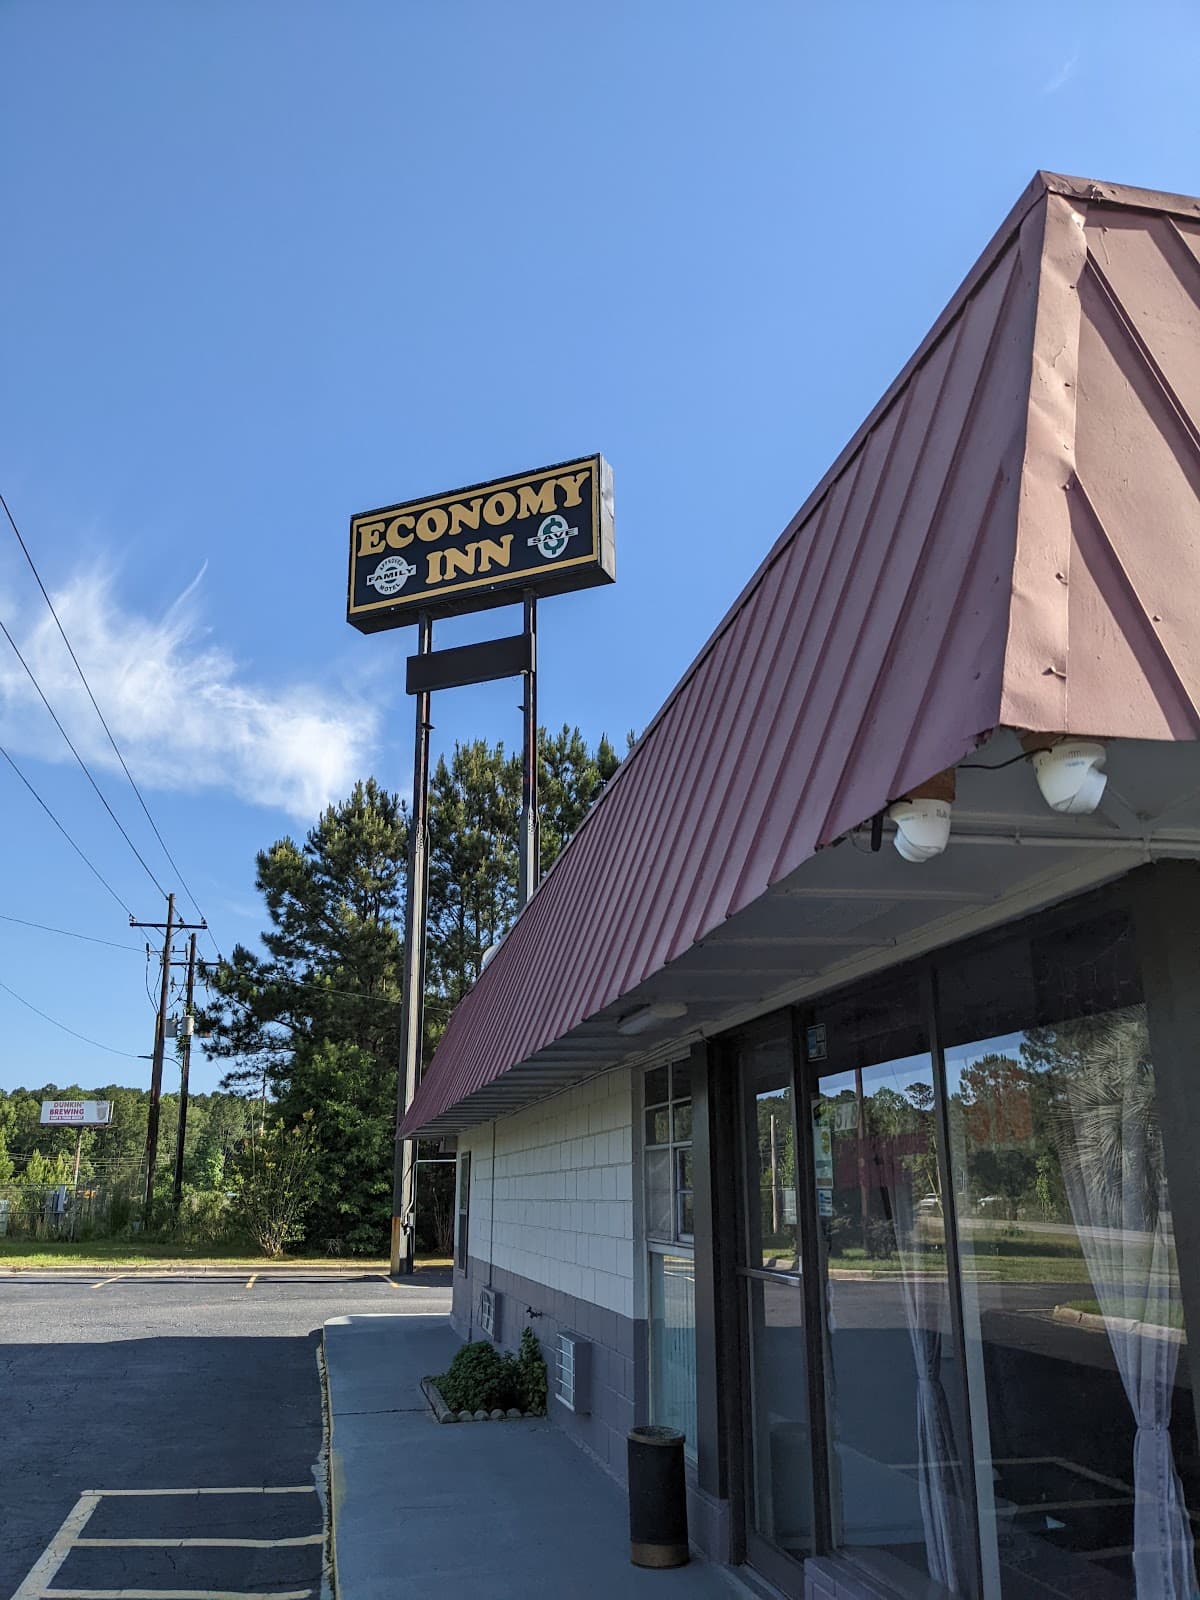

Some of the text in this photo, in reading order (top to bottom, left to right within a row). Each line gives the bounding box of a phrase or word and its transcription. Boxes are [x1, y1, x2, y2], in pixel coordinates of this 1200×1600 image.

[357, 471, 591, 557] ECONOMY
[532, 528, 575, 544] SAVE
[425, 534, 514, 584] INN
[368, 567, 414, 583] FAMILY
[379, 583, 401, 592] MOTEL
